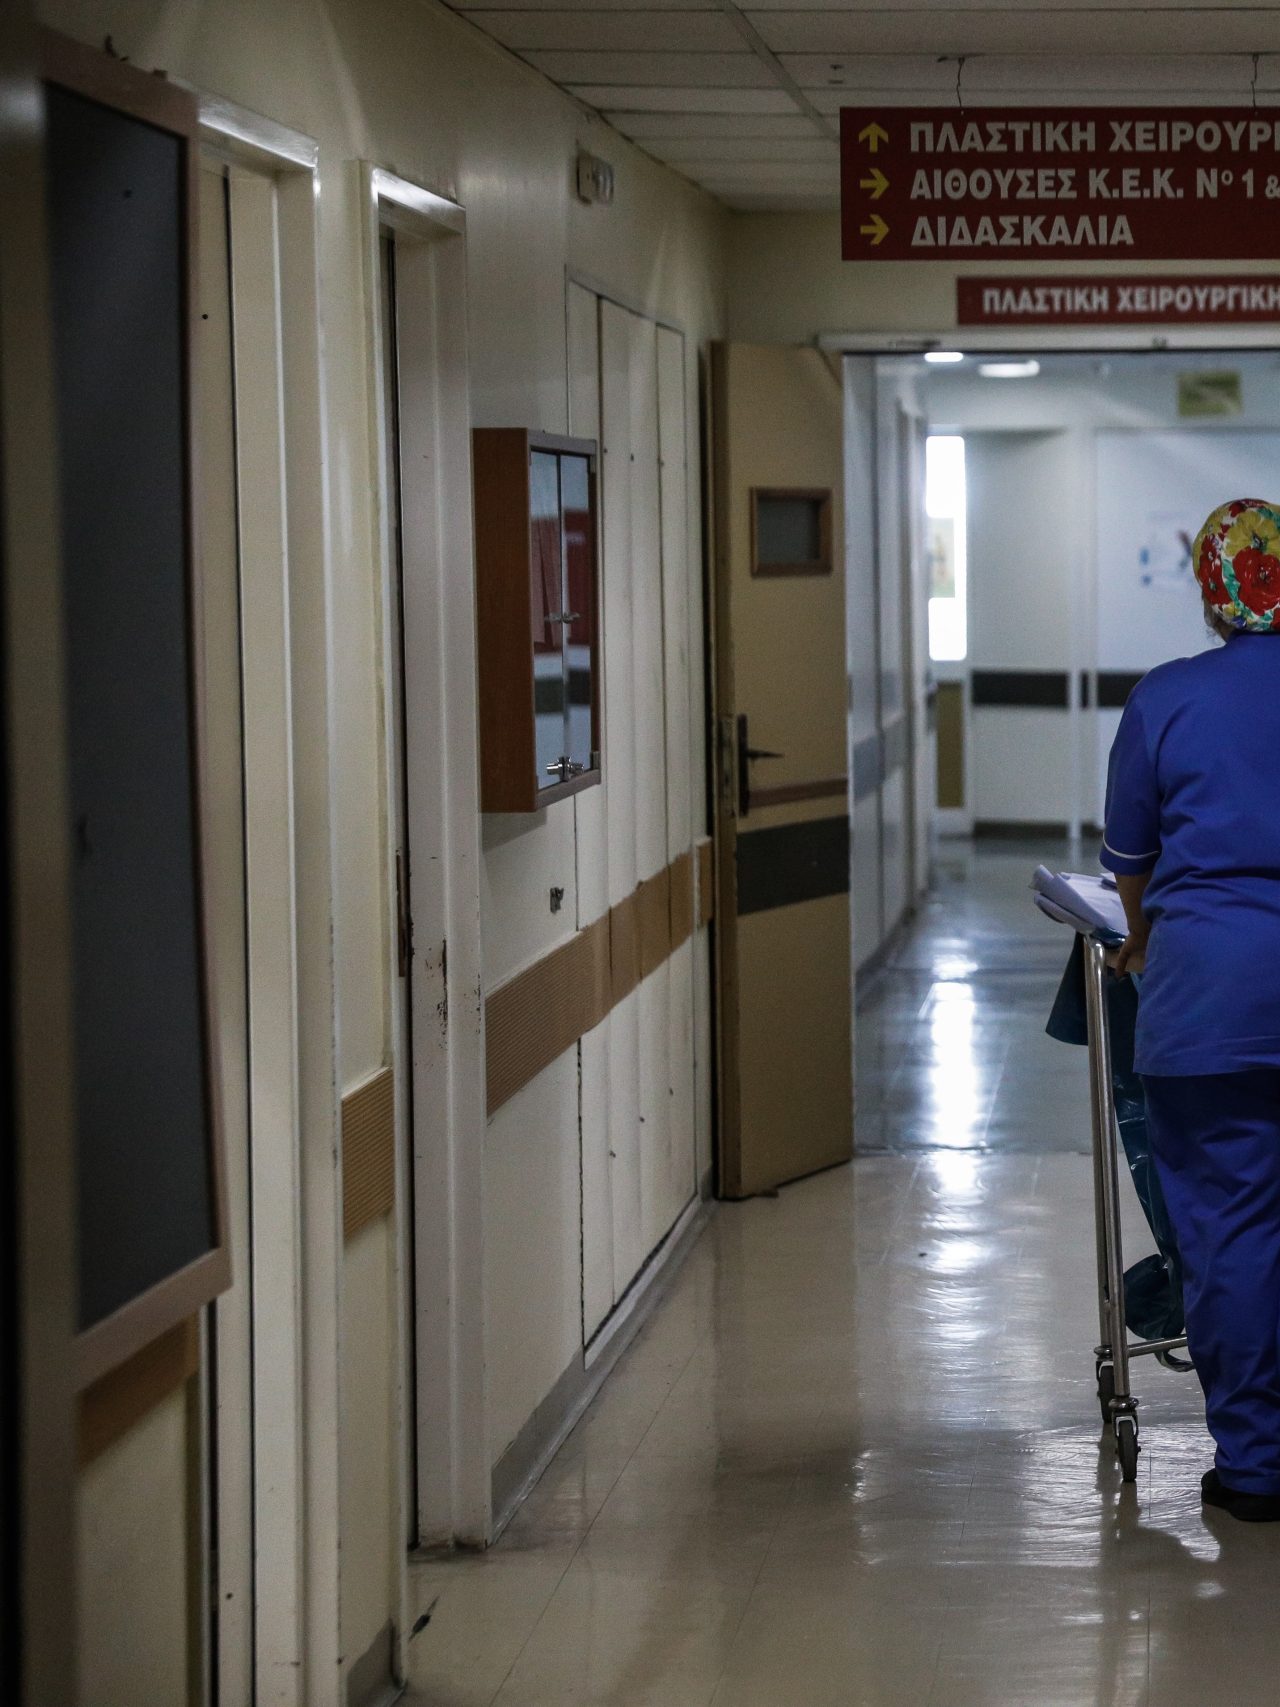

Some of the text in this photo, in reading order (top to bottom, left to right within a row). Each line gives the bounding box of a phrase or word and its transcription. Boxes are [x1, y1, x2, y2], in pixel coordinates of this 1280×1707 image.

[910, 121, 1096, 153] ΠΛΑΣΤΙΚΗ
[910, 168, 1078, 200] ΑΙΘΟΥΣΕΣ
[1088, 168, 1184, 199] Κ.Ε.Κ.
[1241, 168, 1254, 198] 1
[910, 214, 1135, 247] ΔΙΔΑΣΚΑΛΙΑ
[983, 287, 1109, 313] ΠΛΑΣΤΙΚΗ
